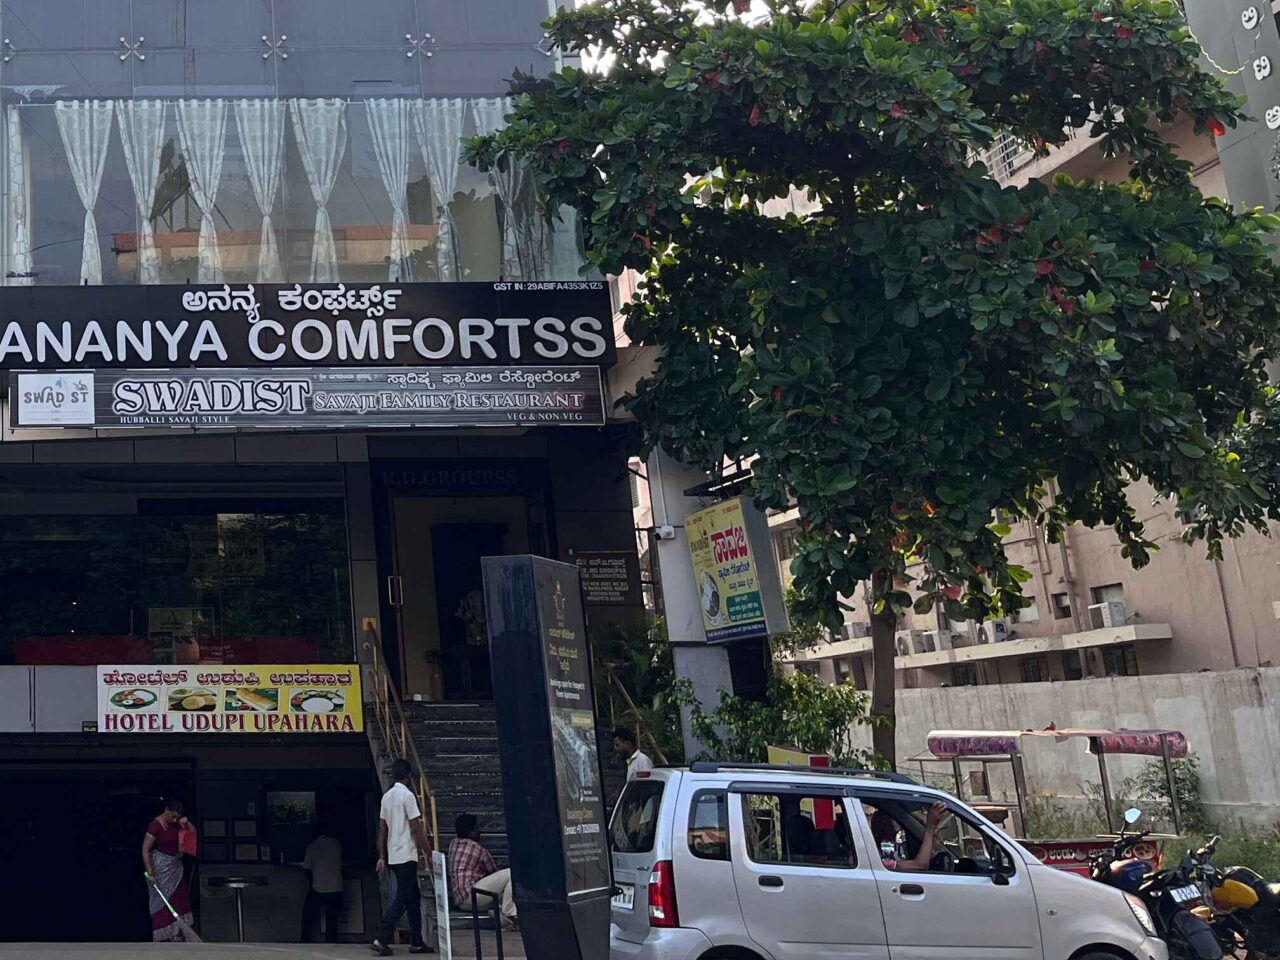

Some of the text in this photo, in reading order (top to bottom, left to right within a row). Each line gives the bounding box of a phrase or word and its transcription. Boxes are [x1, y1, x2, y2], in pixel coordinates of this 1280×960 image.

[493, 282, 512, 291] GST
[182, 284, 261, 323] ಅನನ್ಯ
[249, 316, 607, 361] COMFORTSS
[442, 372, 492, 388] ಫ್ಯಾಮಿಲಿ
[499, 371, 581, 388] ರೆಸ್ಟೋರೆಂಟ್
[112, 378, 312, 414] SWADIST
[314, 392, 584, 412] SAVAJI FAMILY RESTAURANT
[120, 416, 165, 424] HUBBALLI
[168, 416, 199, 425] SAVAJI
[506, 412, 527, 420] VEG
[538, 412, 583, 420] NON-VEG
[103, 669, 353, 685] ಹೋಟೆಲ್ ಉಡುಪಿ ಉಪಹಾರ
[104, 714, 355, 732] HOTEL UDUPI UPAHARA
